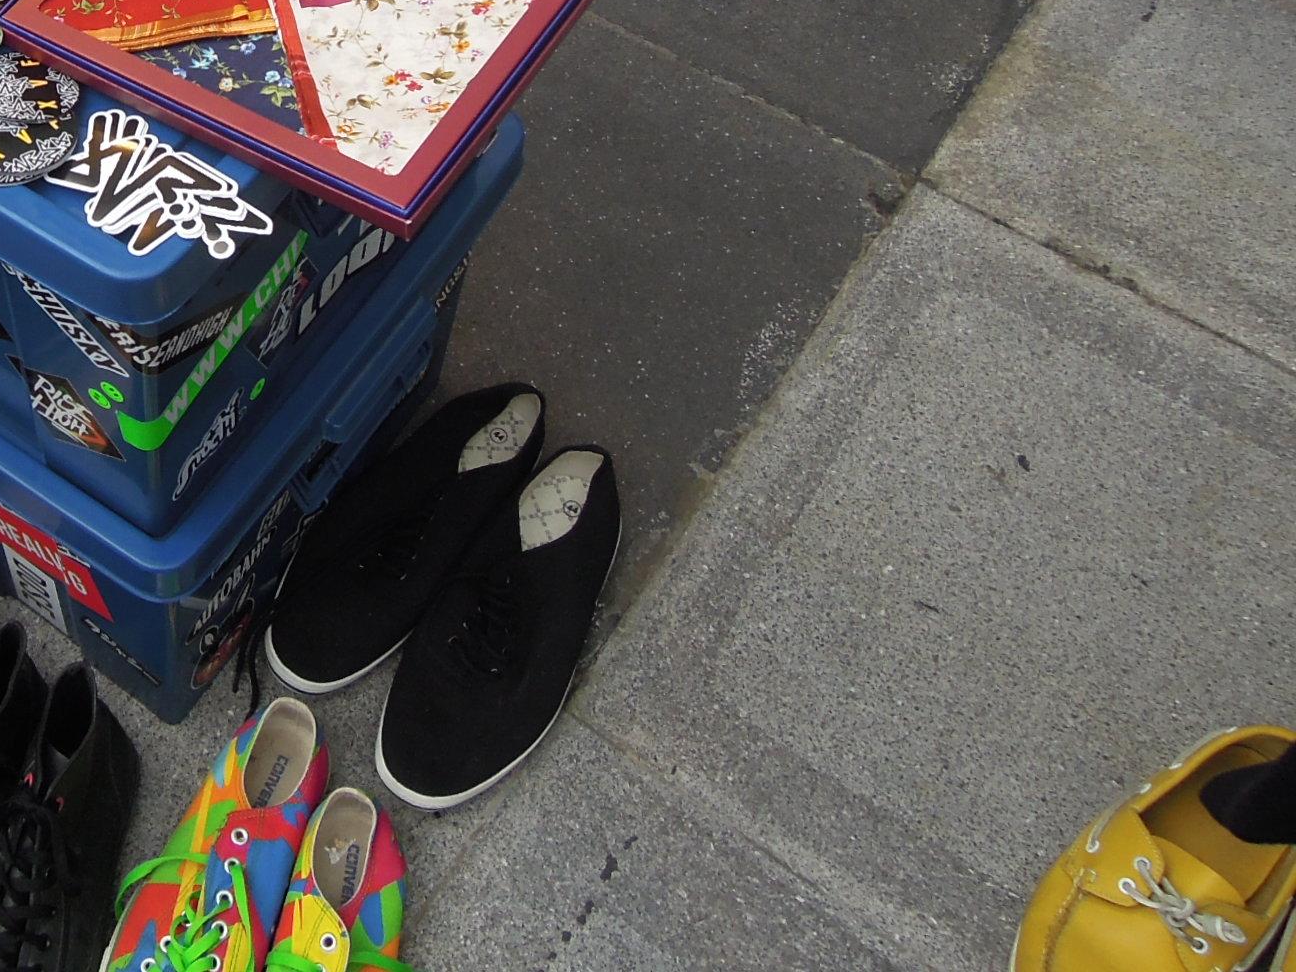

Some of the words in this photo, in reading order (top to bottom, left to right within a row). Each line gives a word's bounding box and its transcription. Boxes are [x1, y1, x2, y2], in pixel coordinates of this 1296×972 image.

[27, 283, 121, 374] HUSKY
[30, 394, 89, 436] HIGH
[34, 374, 93, 423] RISE
[192, 532, 273, 634] AUTOBAHN
